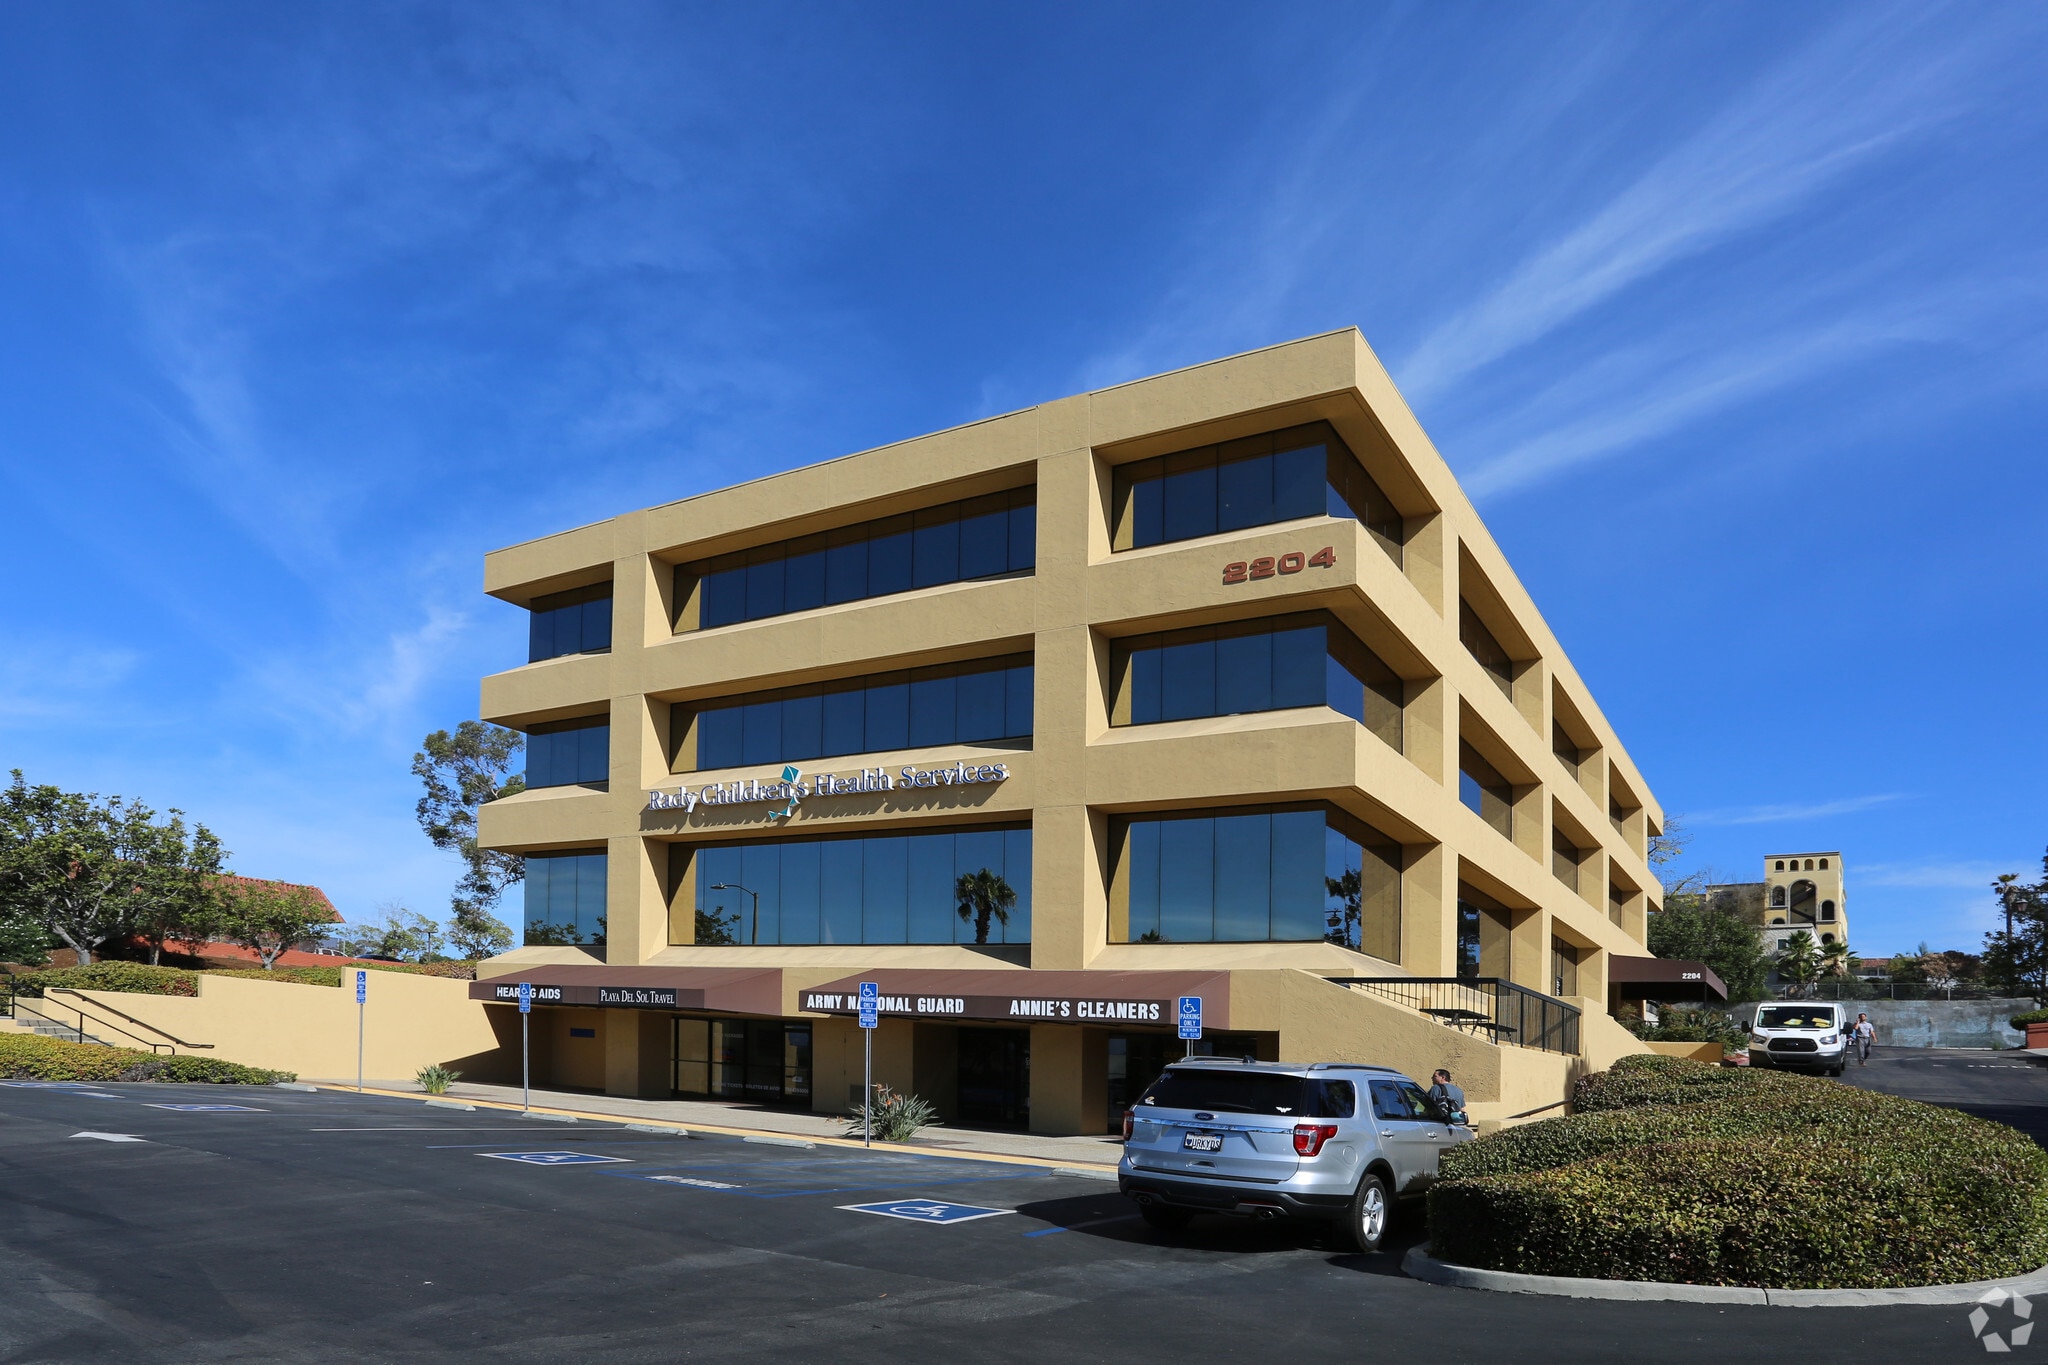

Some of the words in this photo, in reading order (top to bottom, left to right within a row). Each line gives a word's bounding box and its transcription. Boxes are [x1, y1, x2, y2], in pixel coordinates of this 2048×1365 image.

[1223, 546, 1336, 585] 2204
[649, 786, 699, 813] Rady
[814, 767, 894, 797] Health
[900, 761, 1010, 789] Services
[1682, 972, 1701, 980] 2204
[496, 986, 536, 998] HEARG
[538, 988, 561, 1000] AIDS
[806, 994, 842, 1009] ARMY
[847, 995, 912, 1012] NONAL
[917, 997, 964, 1014] GUARD
[1010, 999, 1071, 1017] ANNIE'S
[1077, 1001, 1160, 1020] CLEANERS
